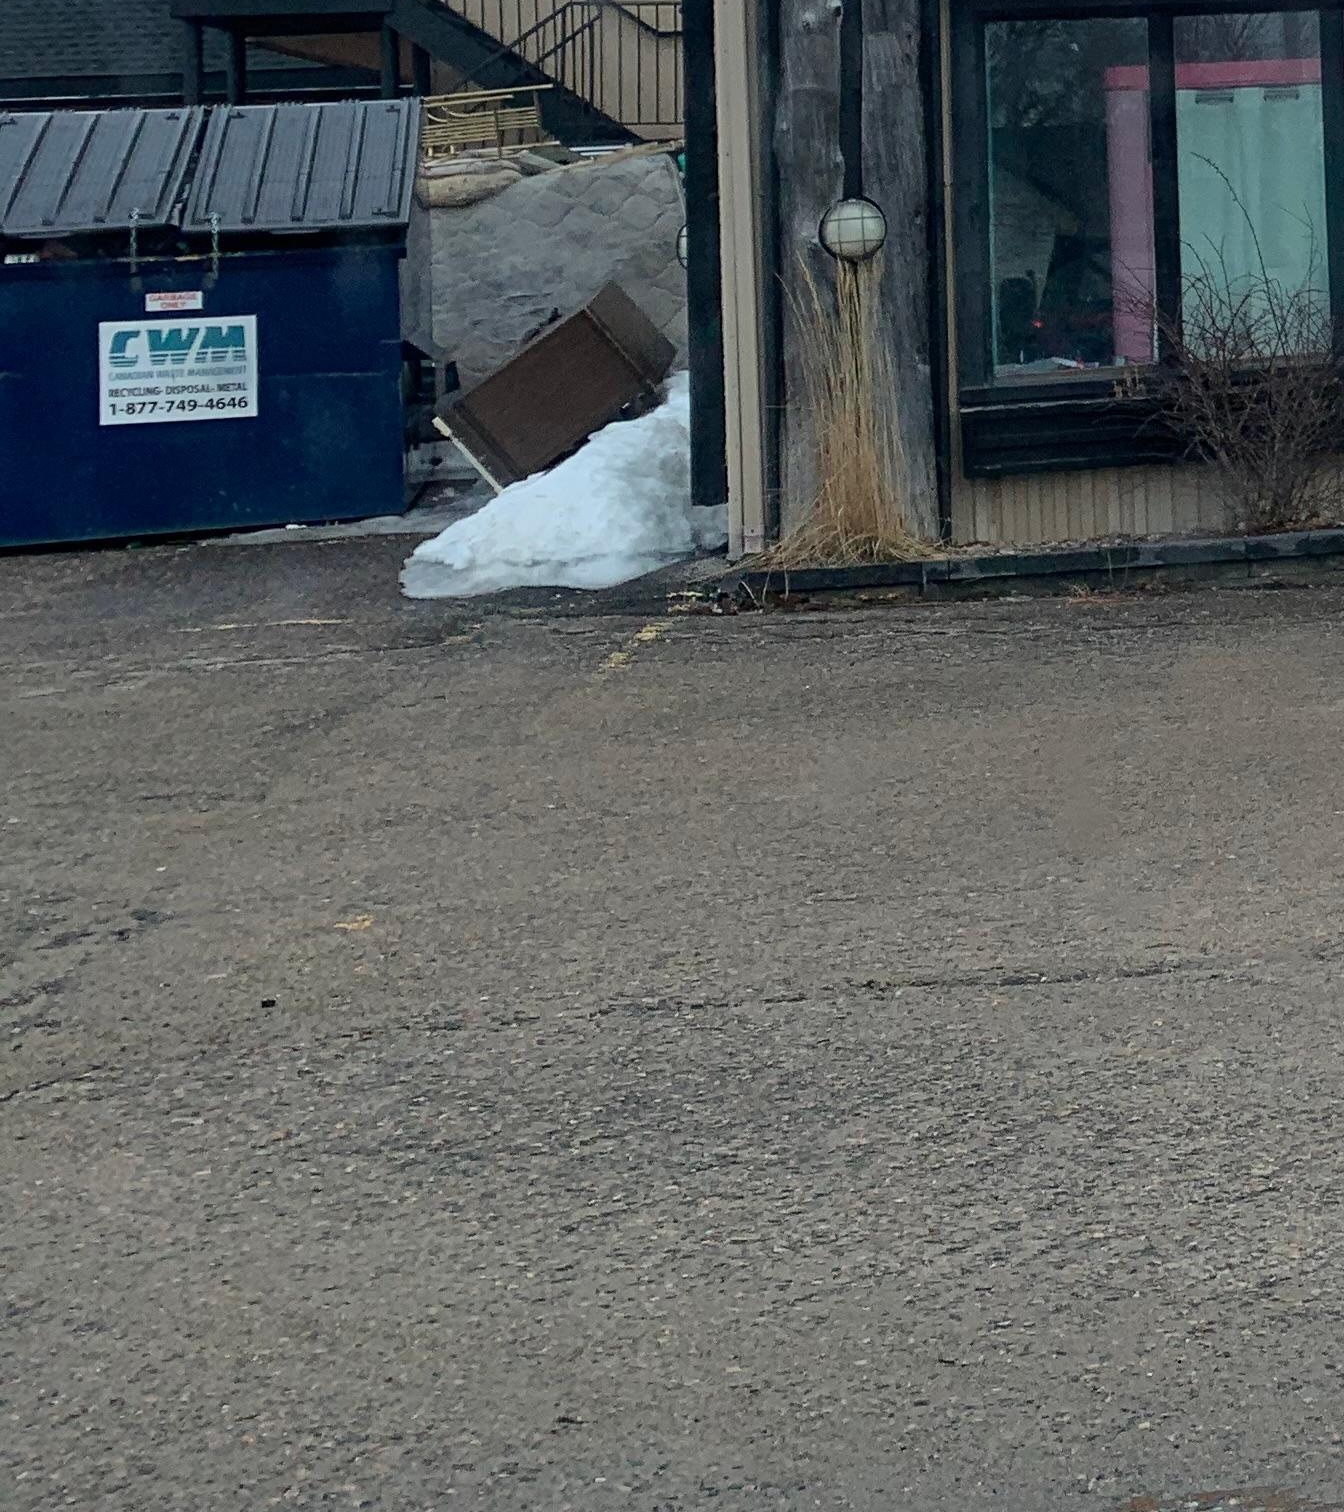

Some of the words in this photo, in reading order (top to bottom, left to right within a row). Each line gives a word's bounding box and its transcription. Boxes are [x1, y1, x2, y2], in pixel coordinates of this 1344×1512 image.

[108, 325, 247, 367] CWM
[217, 382, 248, 393] METAL
[108, 396, 248, 416] 1-877-749-4646
